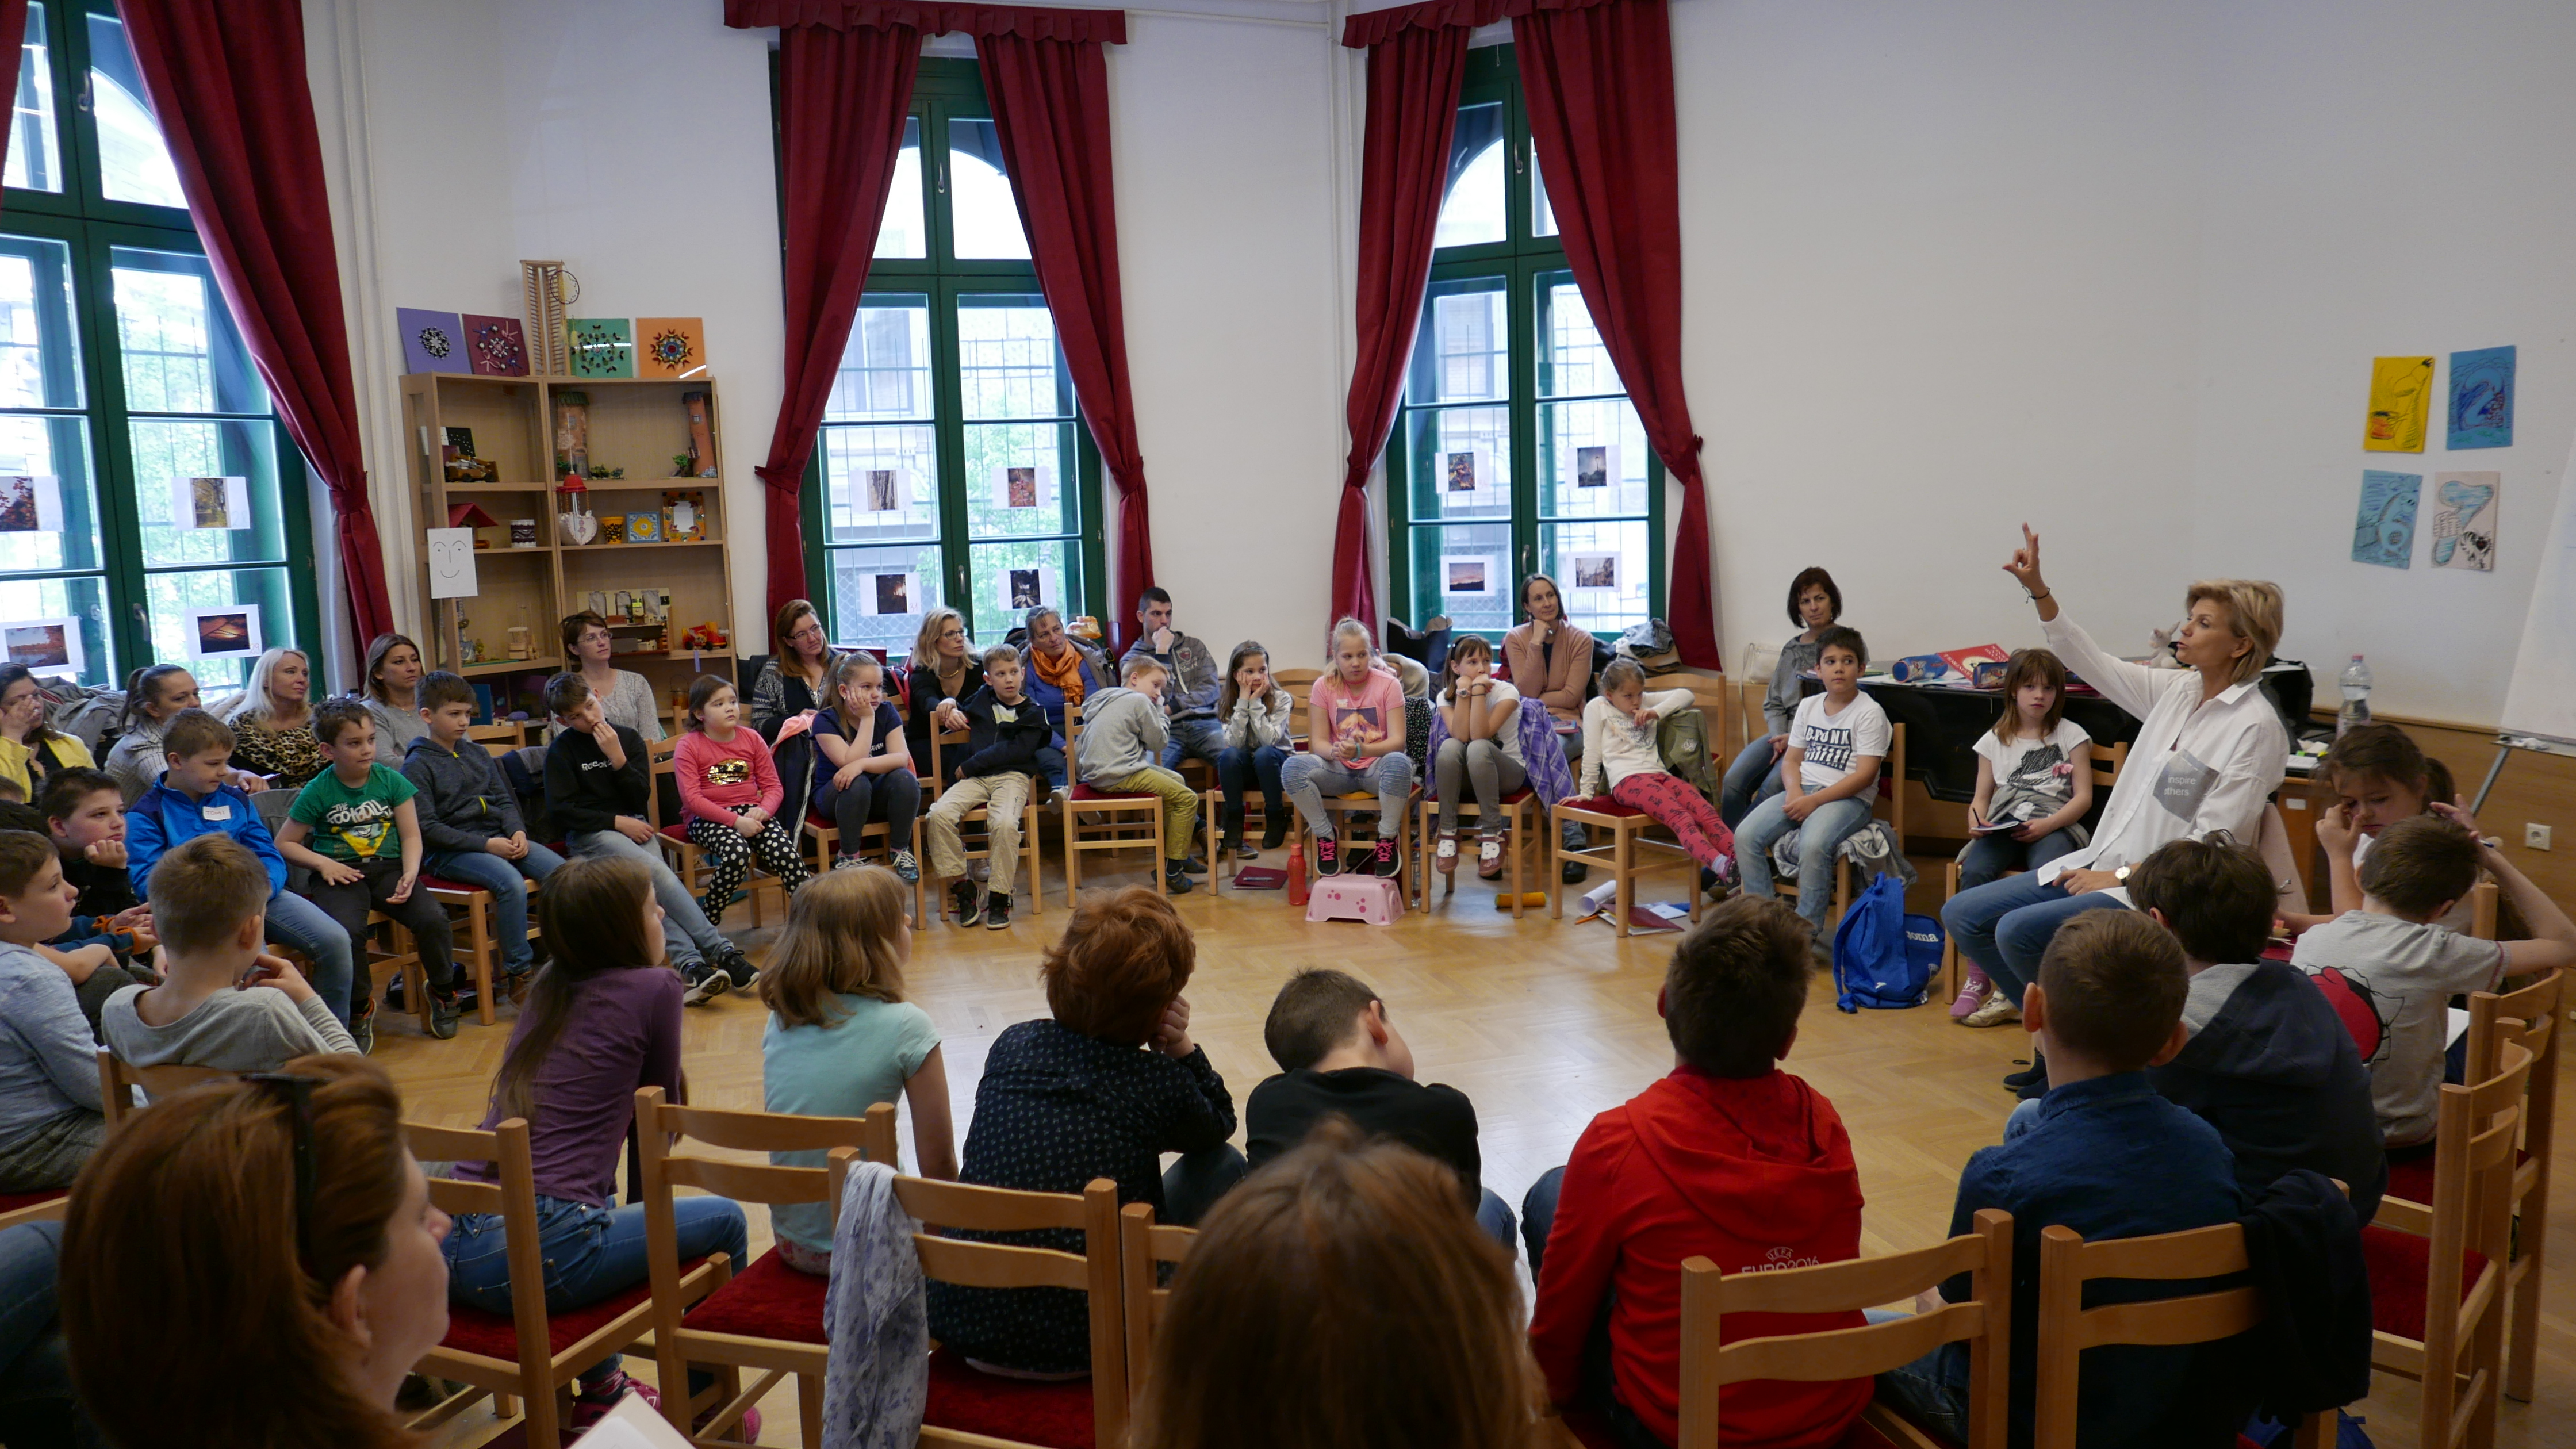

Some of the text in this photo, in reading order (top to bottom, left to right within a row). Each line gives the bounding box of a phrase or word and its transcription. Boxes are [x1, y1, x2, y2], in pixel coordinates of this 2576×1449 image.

[909, 602, 918, 613] 31
[248, 643, 260, 654] 29
[2167, 775, 2196, 785] inspire
[331, 802, 348, 812] THE
[1905, 930, 1939, 943] Joma
